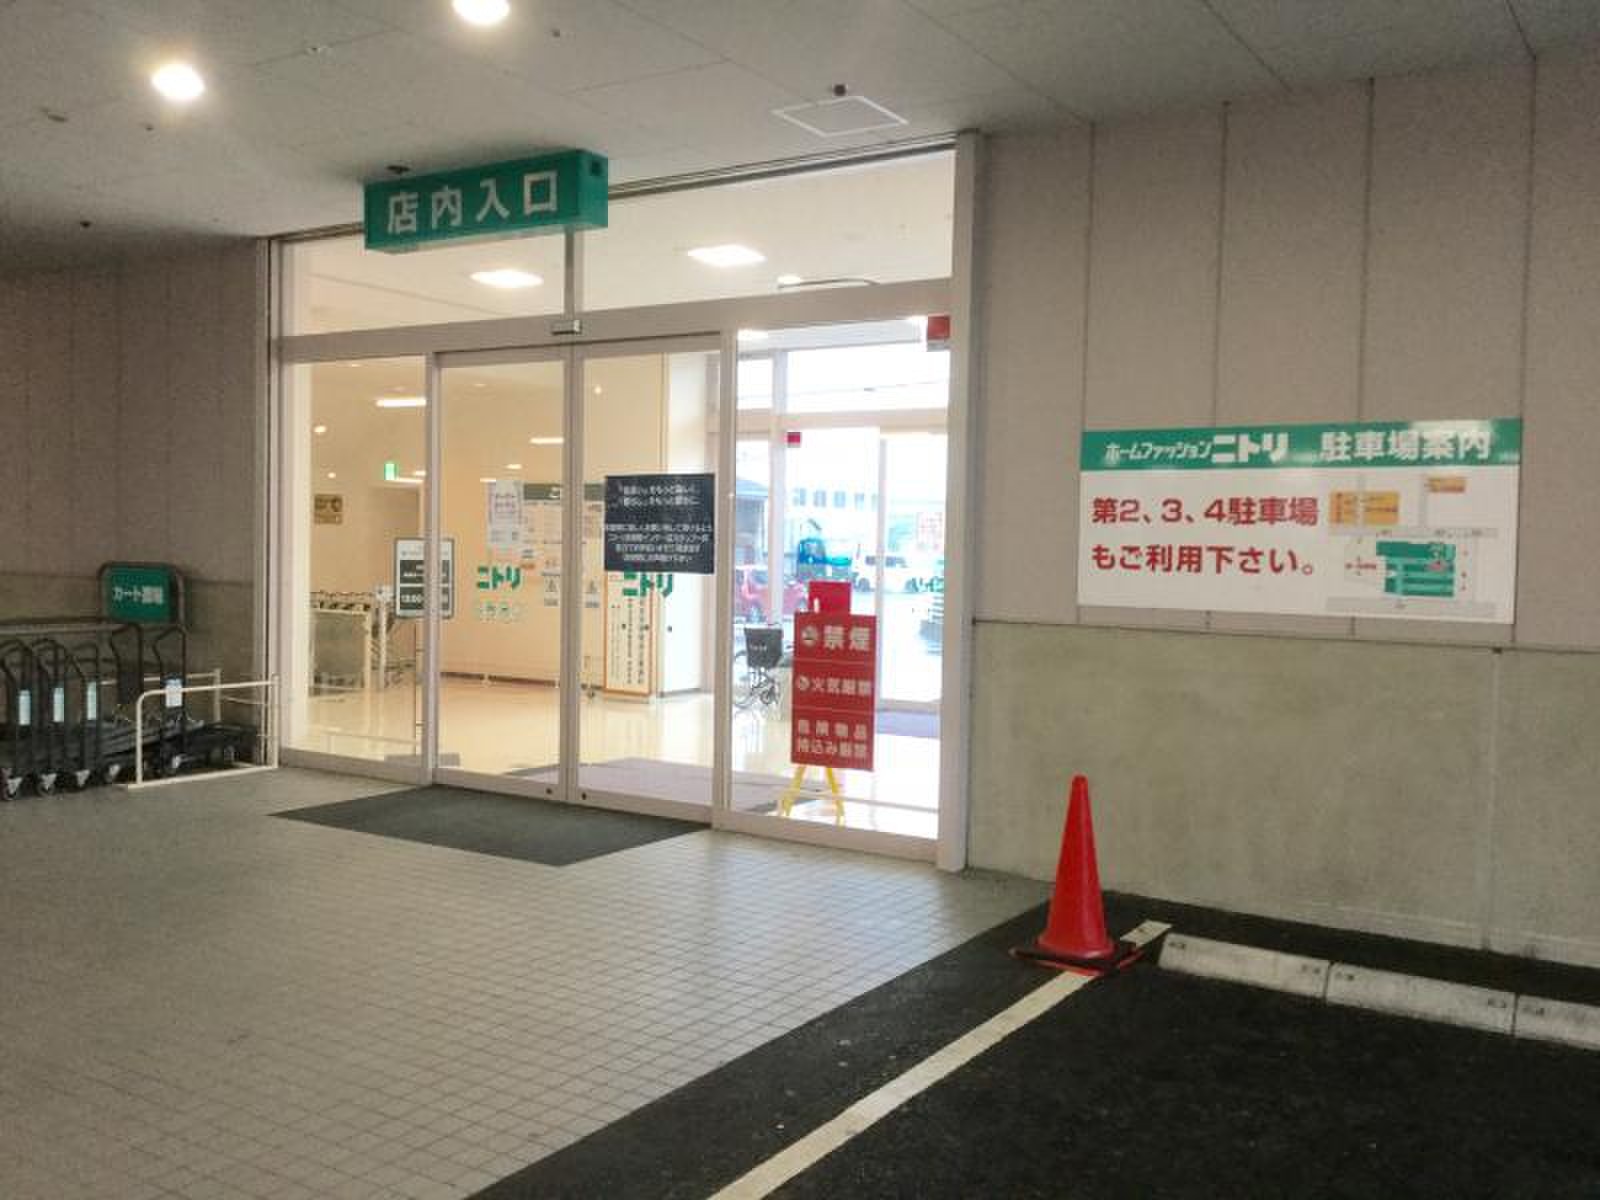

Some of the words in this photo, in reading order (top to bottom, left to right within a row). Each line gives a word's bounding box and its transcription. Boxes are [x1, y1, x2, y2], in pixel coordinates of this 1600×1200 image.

[386, 170, 559, 235] 店内入口
[1105, 441, 1212, 467] ホームファッション
[1211, 432, 1289, 464] ニトリ
[1319, 430, 1492, 462] 駐車場案内
[1092, 544, 1314, 576] もご利用下さい。
[476, 566, 521, 590] ニトリ
[622, 572, 673, 598] ニトリ
